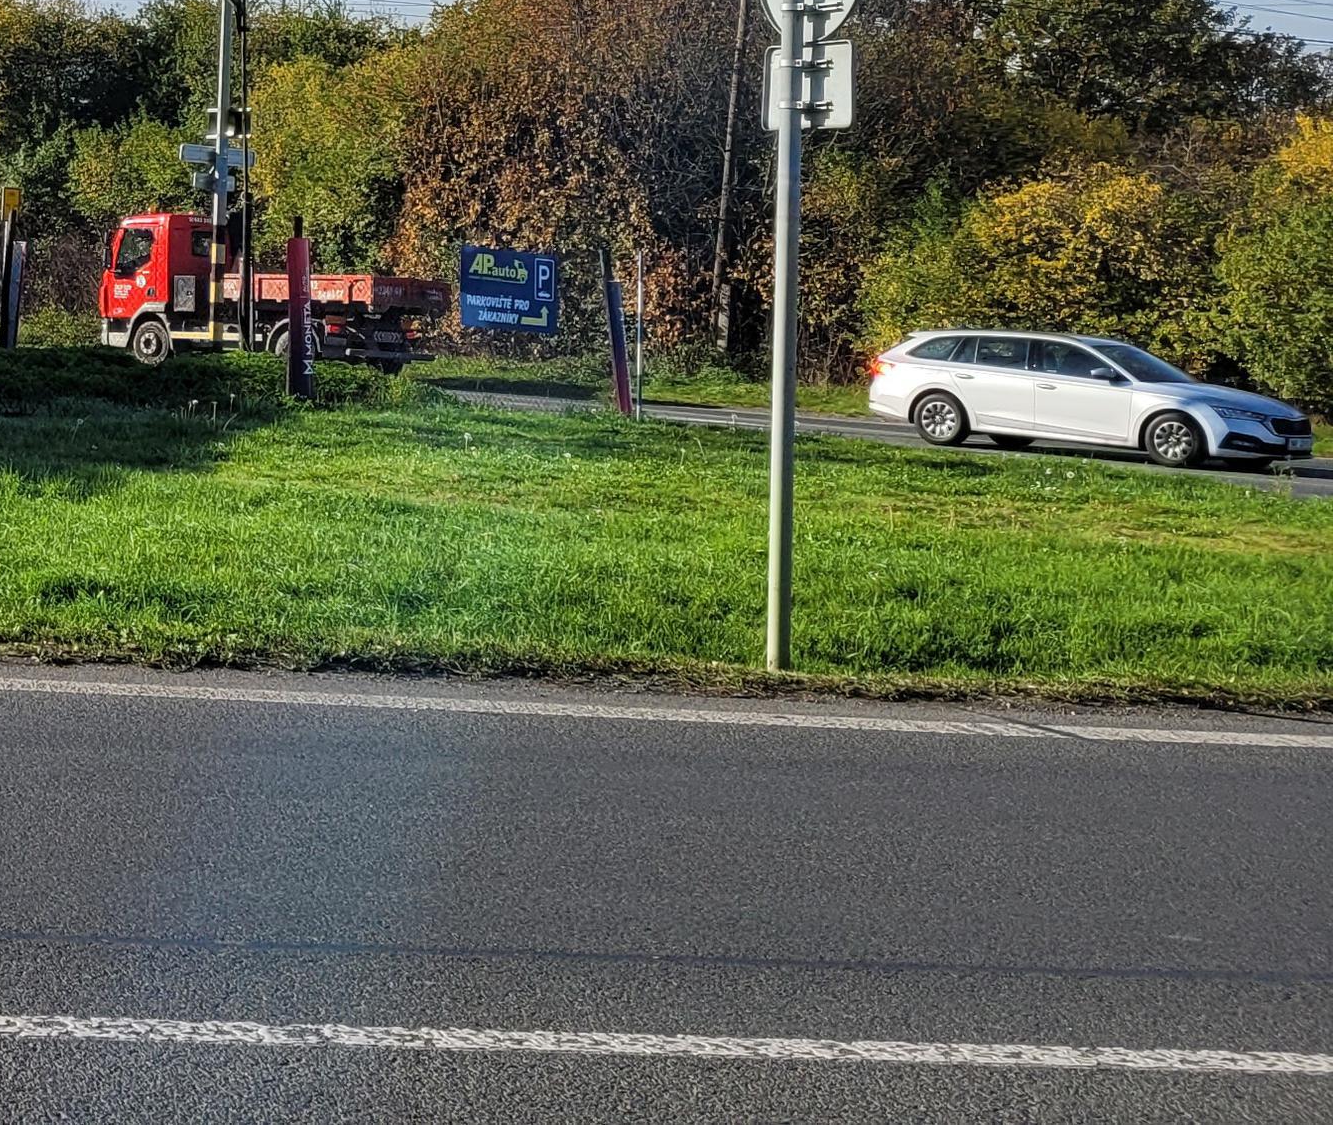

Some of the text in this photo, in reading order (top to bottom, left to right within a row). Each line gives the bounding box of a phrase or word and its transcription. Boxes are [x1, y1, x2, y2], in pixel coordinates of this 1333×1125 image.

[469, 254, 516, 278] AP.auto
[538, 265, 550, 289] P
[466, 294, 530, 311] PARKOVIŠTĚ PRO
[478, 310, 519, 324] ZÁKAZNÍKY
